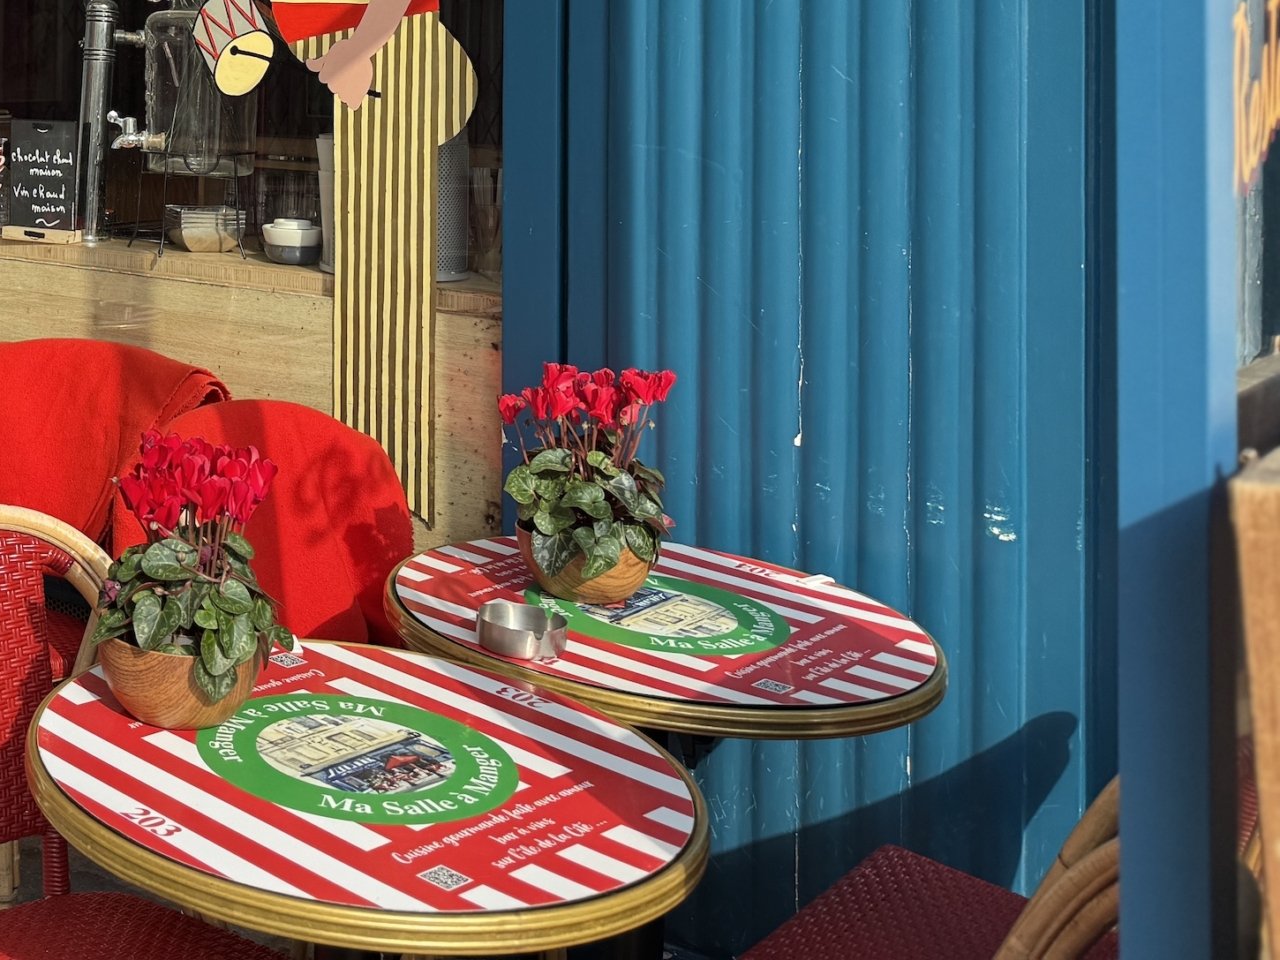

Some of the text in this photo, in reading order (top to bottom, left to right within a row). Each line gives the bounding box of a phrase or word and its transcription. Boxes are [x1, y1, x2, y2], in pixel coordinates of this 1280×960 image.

[11, 147, 50, 163] chocolat
[29, 165, 63, 177] maison
[649, 636, 695, 649] Ma
[697, 638, 755, 650] Salle
[262, 699, 330, 713] Salle
[496, 686, 552, 709] 203
[340, 699, 387, 717] Ma
[318, 744, 503, 816] Ma Salle à Manger
[120, 807, 182, 838] 203
[391, 840, 444, 864] Cuisine
[442, 813, 510, 847] gourmande
[488, 832, 518, 845] bar
